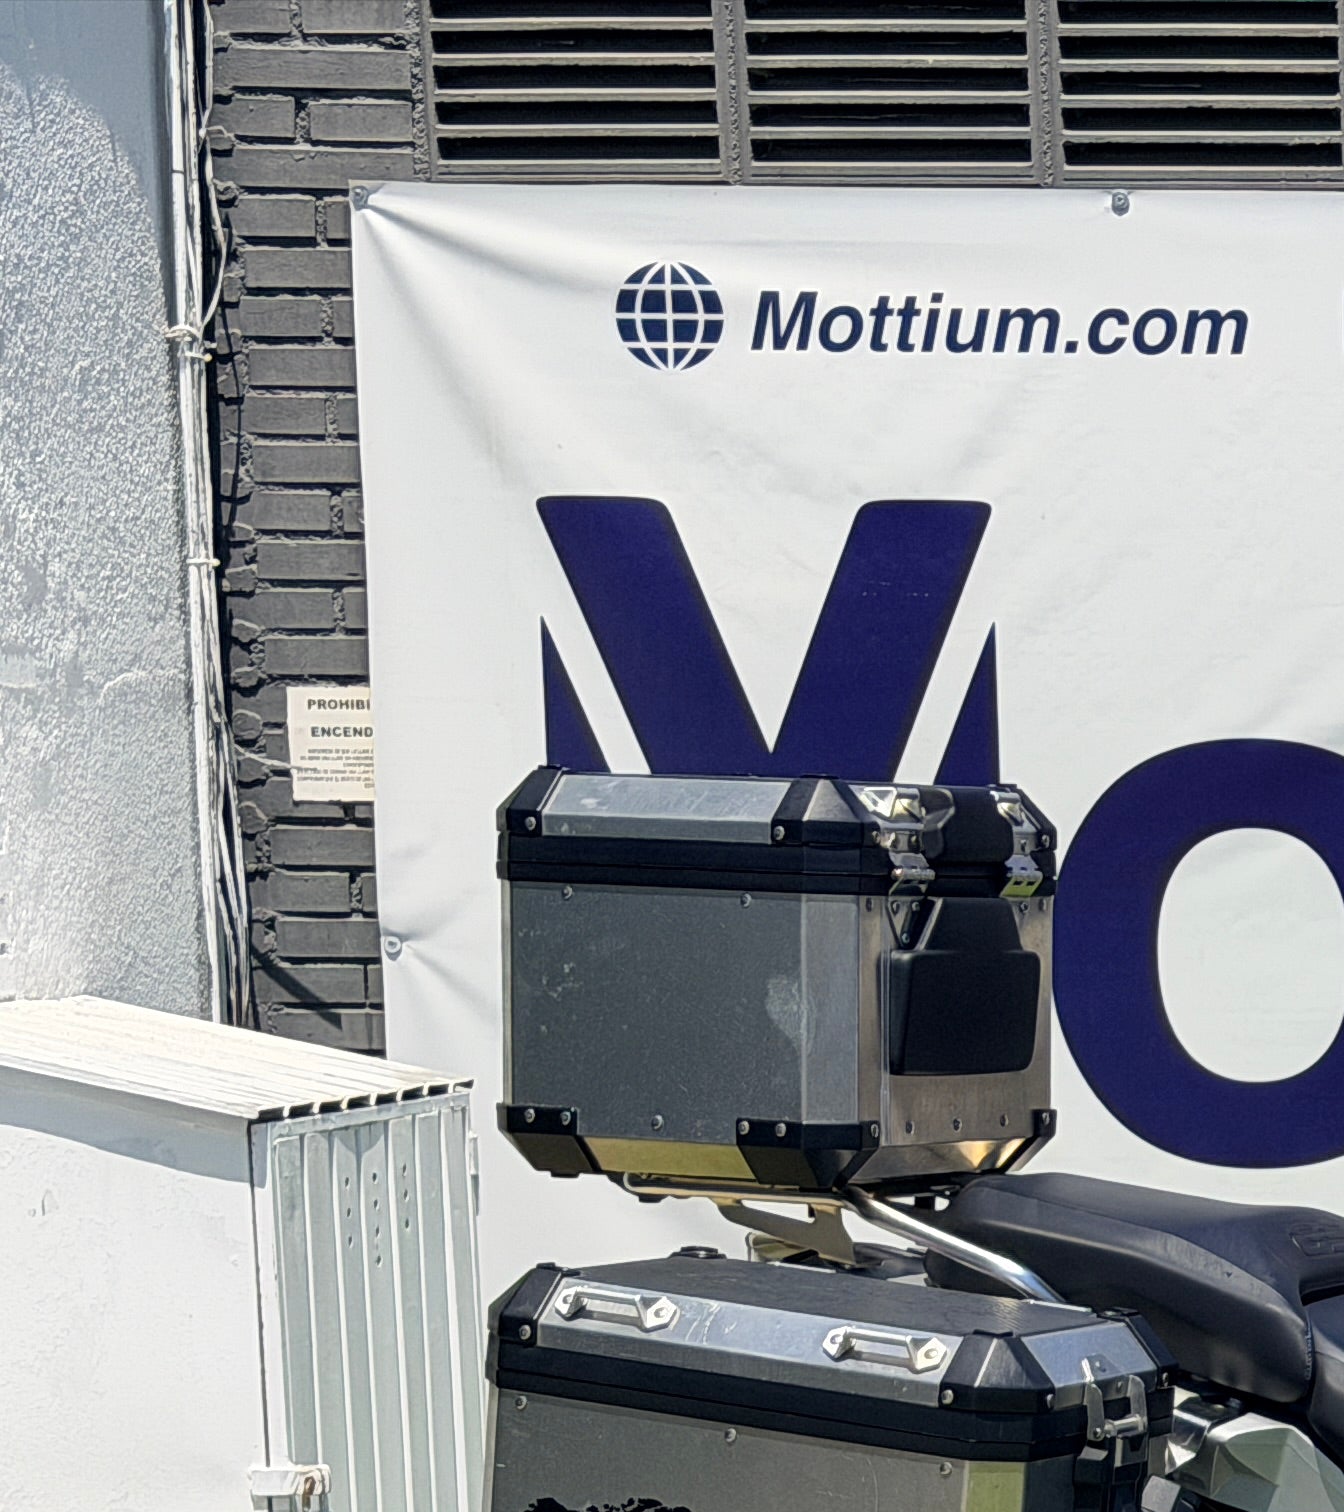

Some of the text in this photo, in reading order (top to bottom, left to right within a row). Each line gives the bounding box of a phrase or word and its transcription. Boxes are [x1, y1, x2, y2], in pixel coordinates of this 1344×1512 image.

[752, 291, 1248, 355] Mottium.com
[307, 699, 370, 710] PROHIBI
[311, 726, 374, 738] ENCEND
